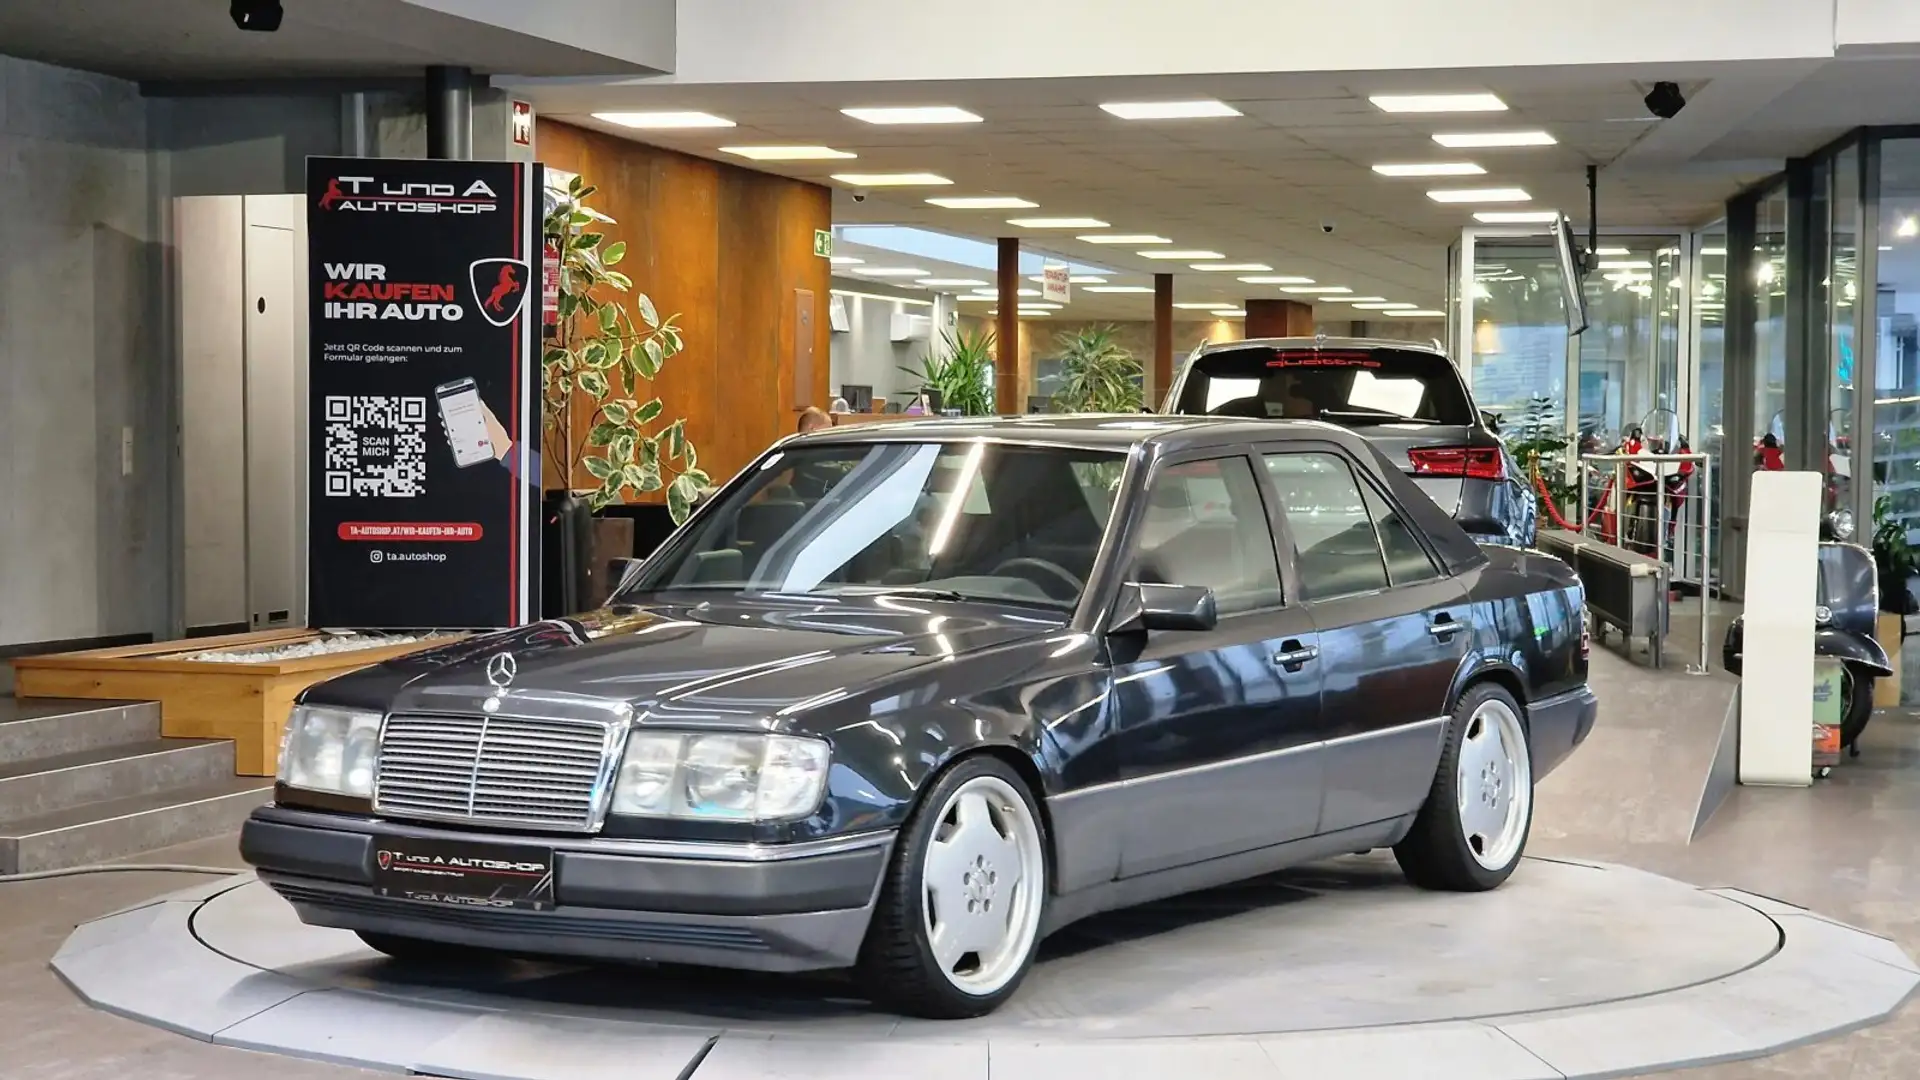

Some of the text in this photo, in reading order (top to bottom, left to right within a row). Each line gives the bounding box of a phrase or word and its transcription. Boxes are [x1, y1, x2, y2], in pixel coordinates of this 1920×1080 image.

[338, 176, 374, 194] T
[462, 180, 497, 198] A
[338, 200, 497, 214] AUTOSHOP
[324, 262, 386, 281] WIR
[324, 282, 454, 301] KAUFEN
[325, 302, 464, 321] IHR AUTO
[324, 343, 345, 352] Jetzt
[346, 343, 360, 352] QR
[362, 343, 384, 352] Code
[386, 345, 423, 353] scannen
[424, 344, 442, 353] und
[324, 353, 408, 364] Formular gelangen:
[1266, 359, 1381, 367] quattro
[362, 436, 390, 446] SCAN
[362, 447, 390, 457] MICH
[387, 551, 447, 563] ta.autoshop
[393, 852, 404, 860] T
[433, 855, 445, 864] A
[449, 858, 545, 871] AUTOSHOP
